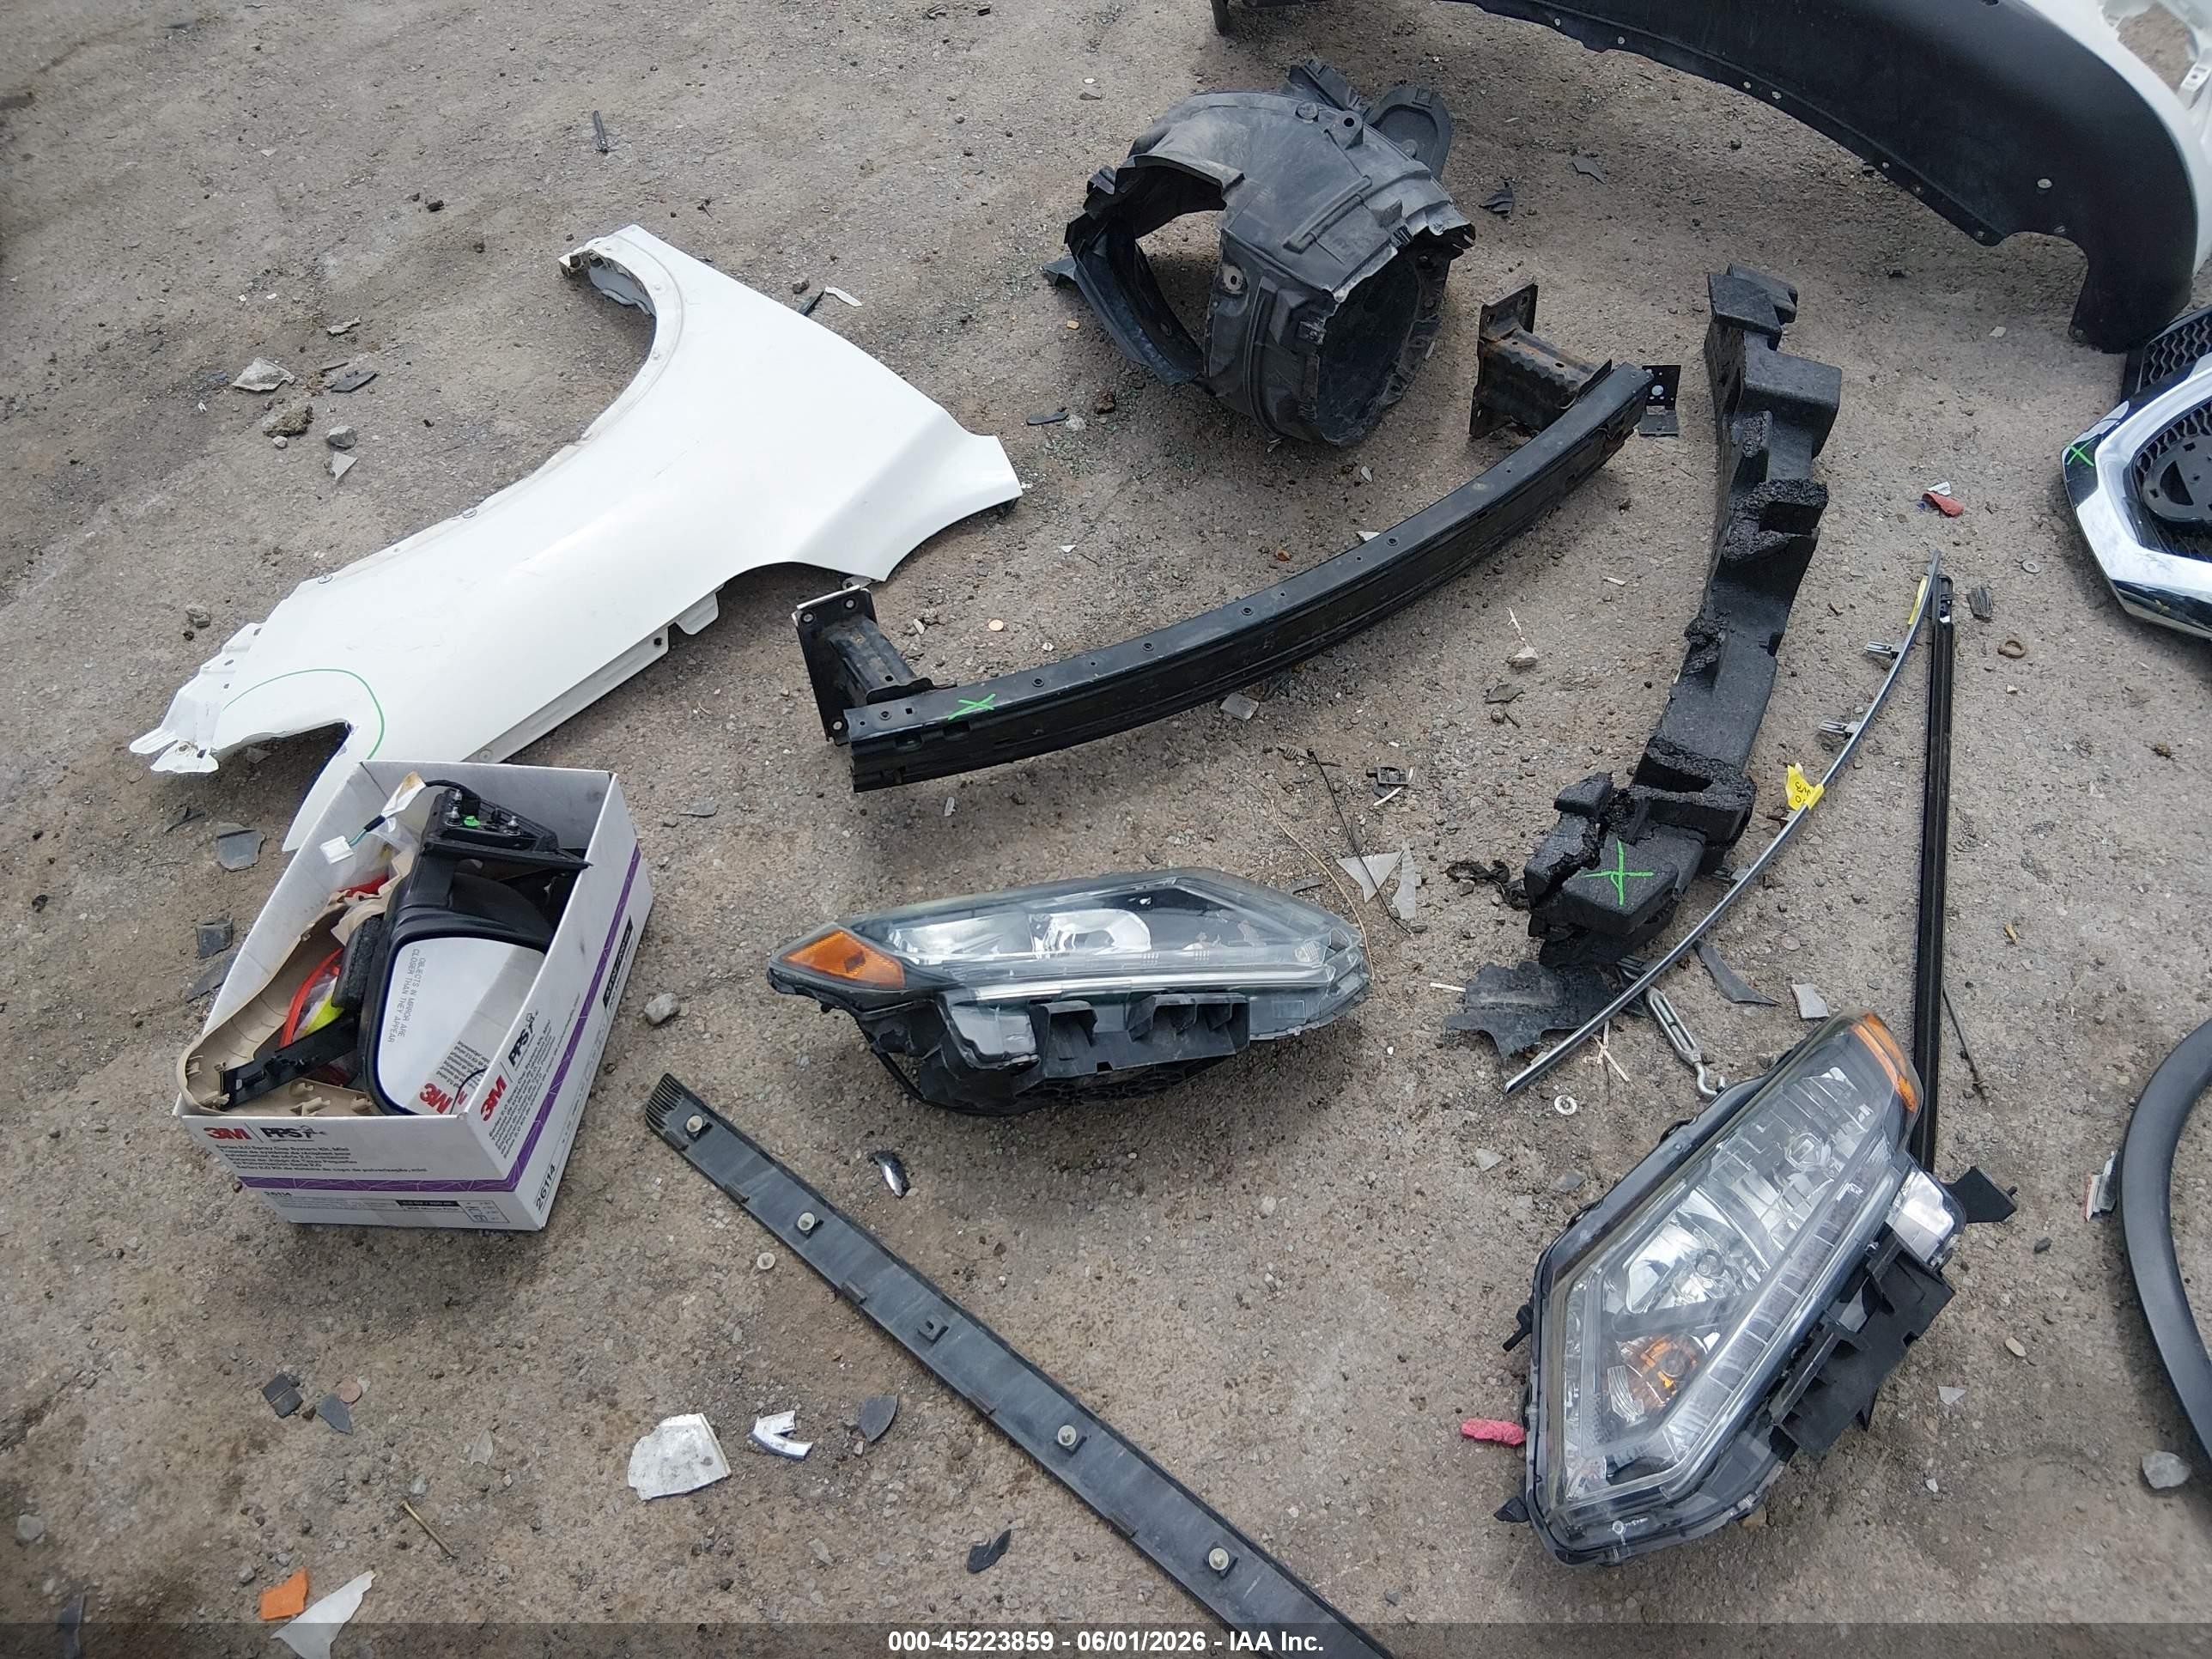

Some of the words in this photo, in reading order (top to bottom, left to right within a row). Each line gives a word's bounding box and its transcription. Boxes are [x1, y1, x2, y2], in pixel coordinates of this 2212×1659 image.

[407, 949, 420, 974] CLOSER
[412, 957, 426, 987] OBJECTS
[402, 977, 412, 994] THAN
[397, 998, 405, 1013] THEY
[403, 998, 415, 1021] MIRROR
[387, 1016, 400, 1042] APPEAR
[398, 1024, 407, 1037] ARE
[480, 1074, 507, 1121] 3M
[204, 1127, 252, 1139] 3M
[536, 1163, 556, 1210] 26114
